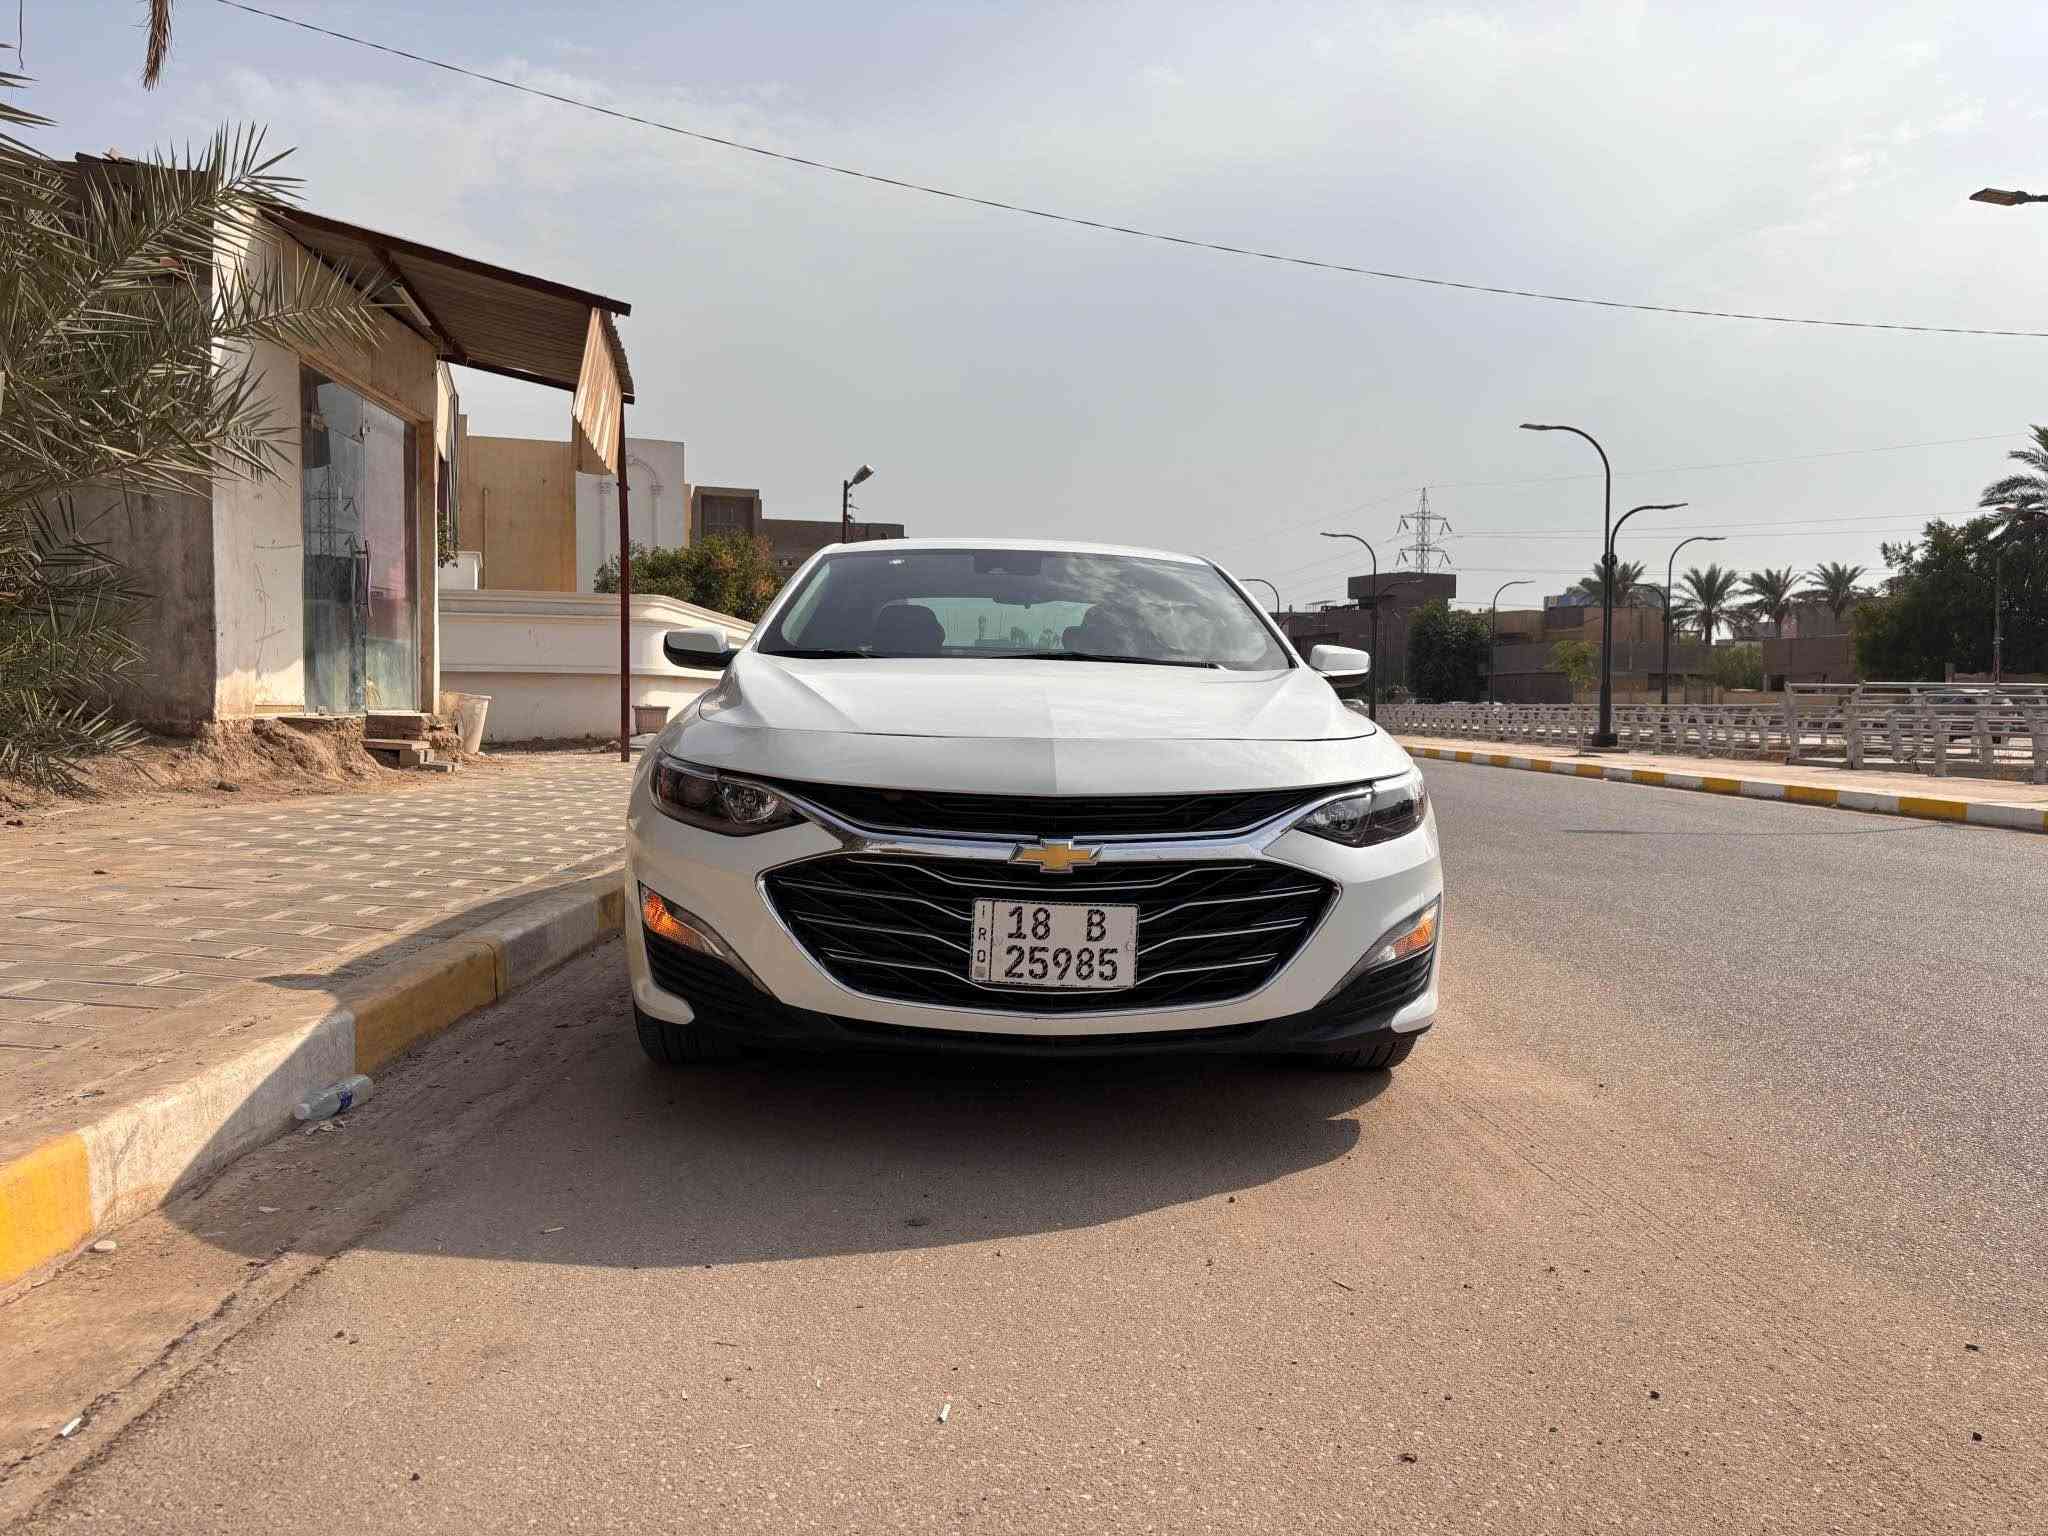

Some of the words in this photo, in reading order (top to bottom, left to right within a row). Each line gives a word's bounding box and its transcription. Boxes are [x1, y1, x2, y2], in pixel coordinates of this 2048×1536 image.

[1008, 906, 1050, 940] 18
[1086, 908, 1106, 942] B
[1004, 944, 1118, 981] 25985
